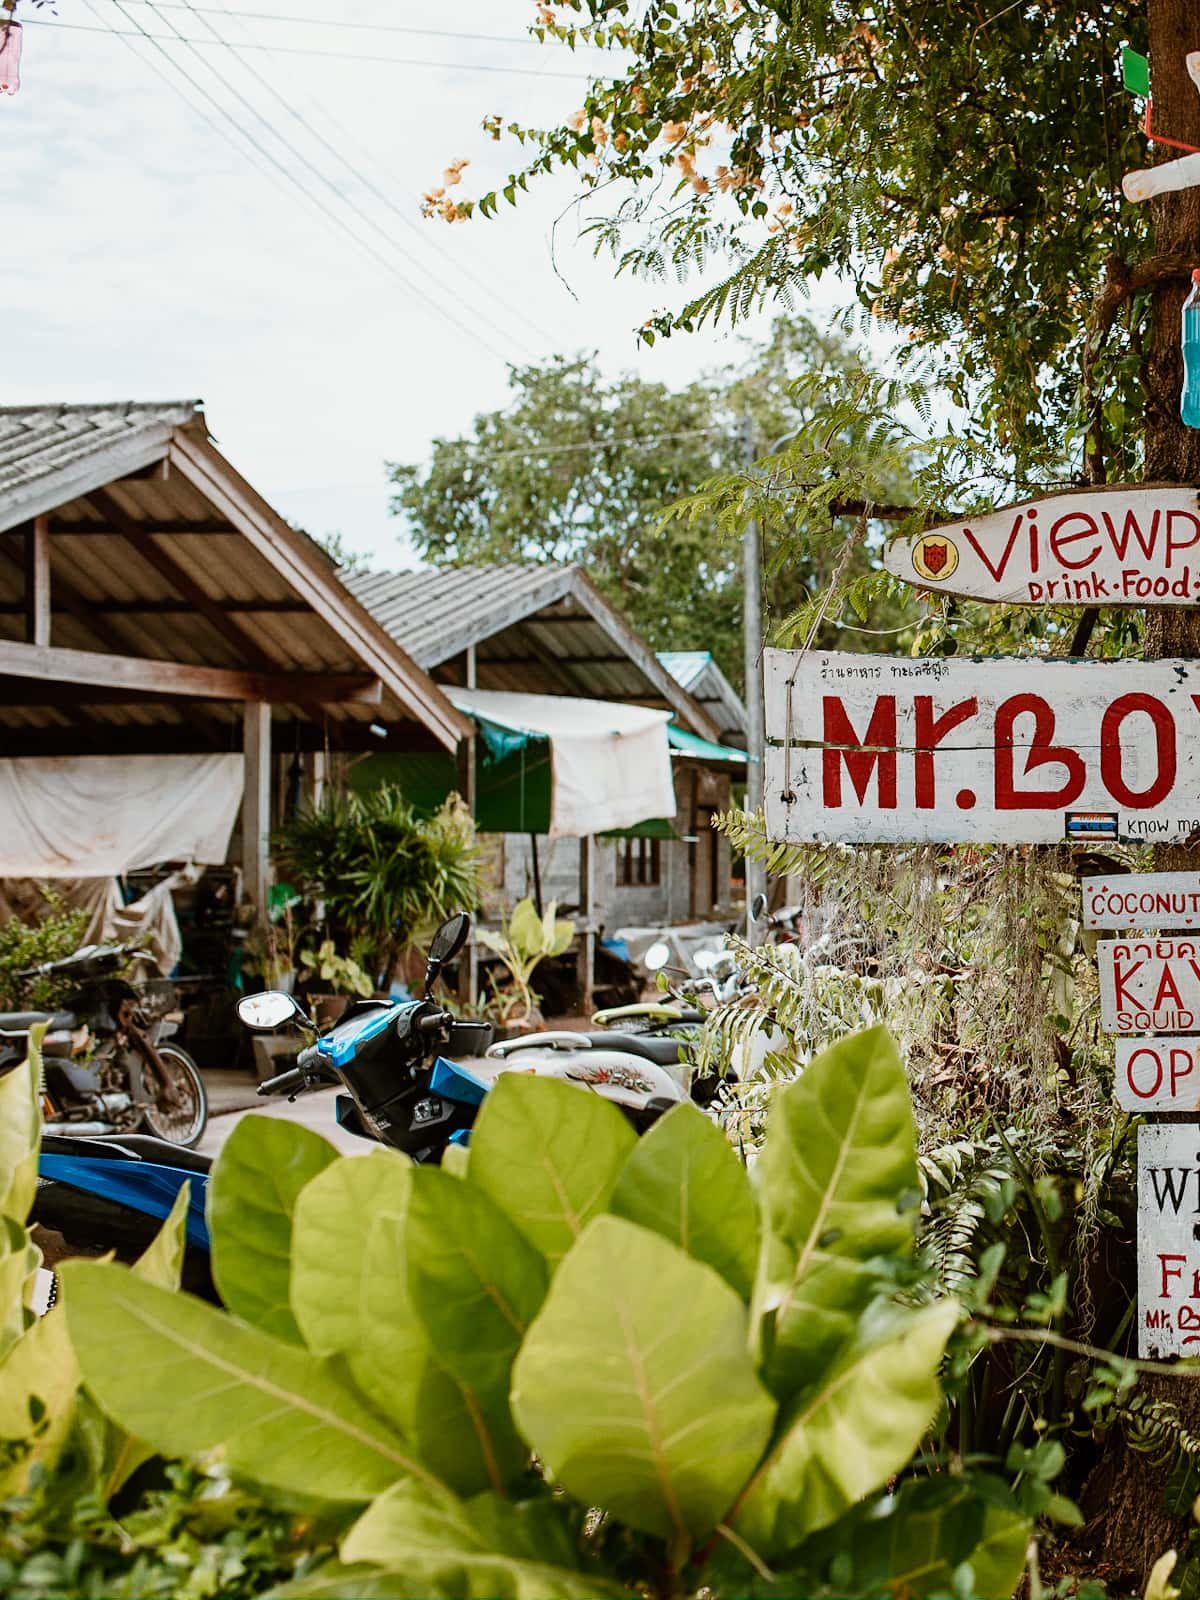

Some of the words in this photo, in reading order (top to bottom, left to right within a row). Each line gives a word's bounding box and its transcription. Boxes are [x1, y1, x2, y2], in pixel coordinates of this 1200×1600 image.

[1178, 820, 1200, 832] me
[1113, 940, 1196, 961] คายัค
[1116, 1009, 1194, 1031] SQUID
[1146, 1309, 1171, 1329] Mr.
